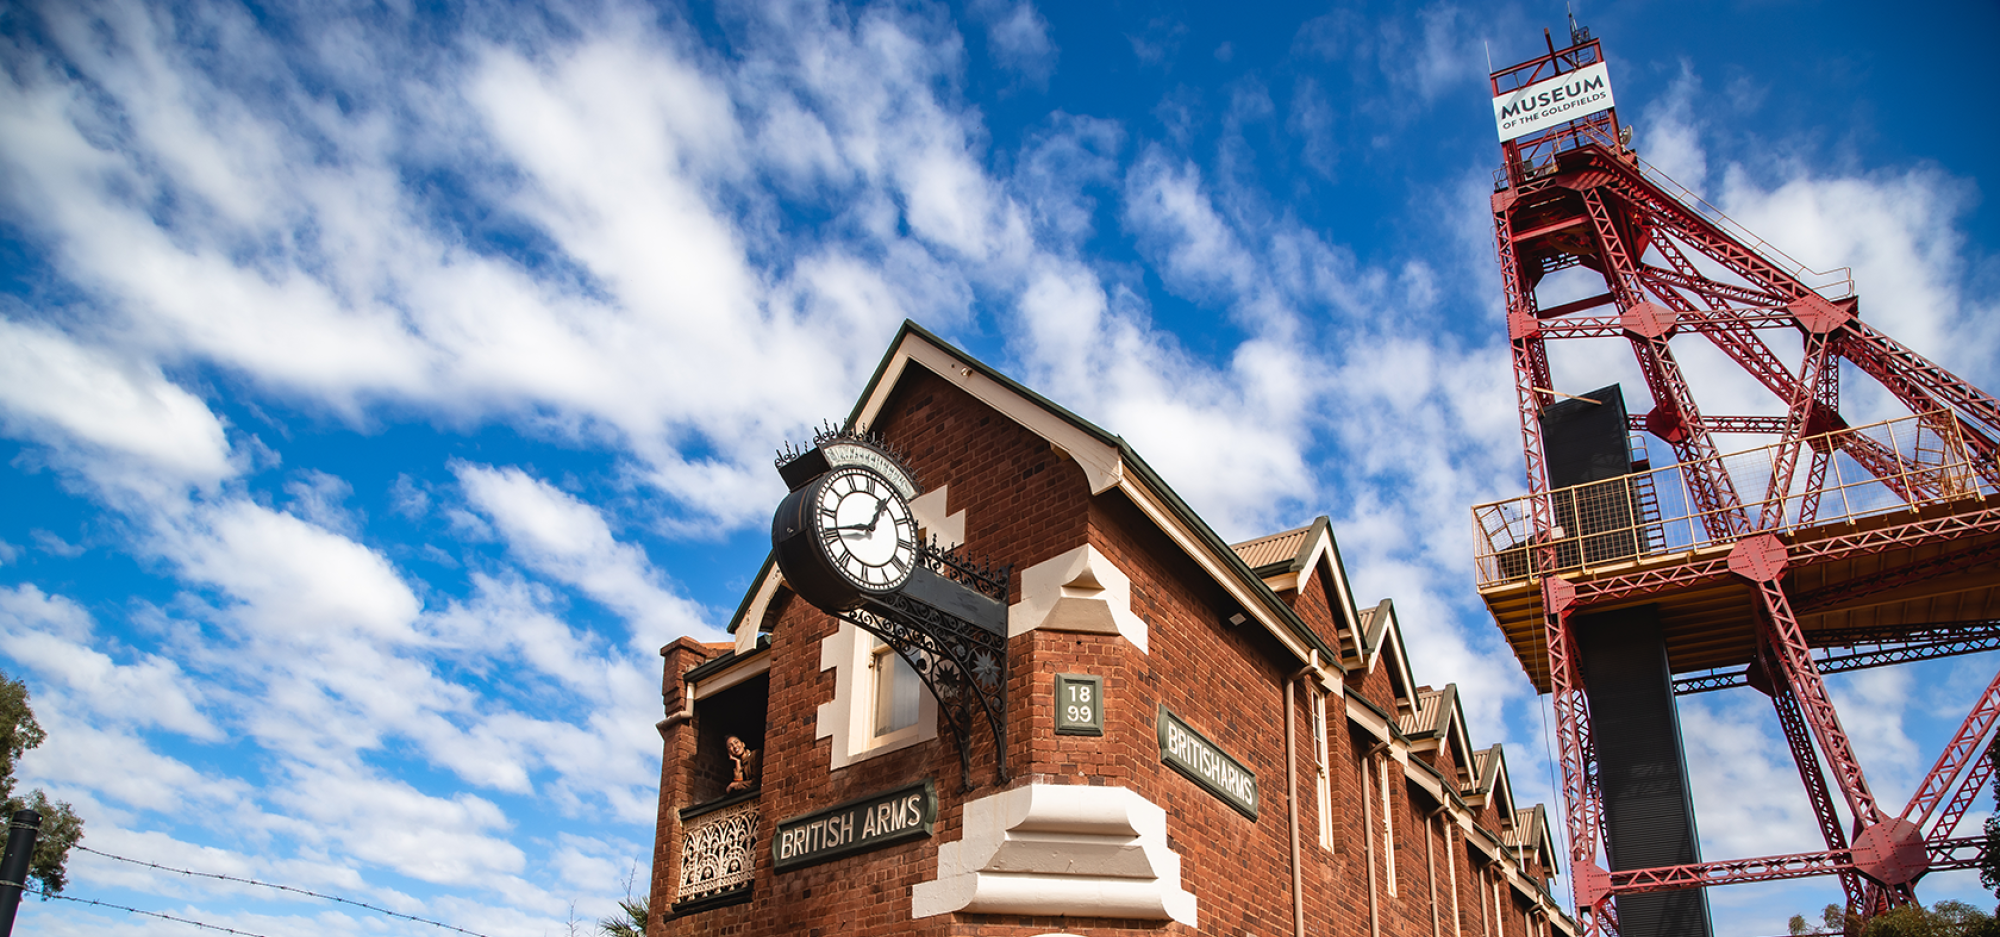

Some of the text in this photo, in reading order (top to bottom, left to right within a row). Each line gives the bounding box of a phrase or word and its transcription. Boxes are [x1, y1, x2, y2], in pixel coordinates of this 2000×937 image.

[1501, 74, 1604, 119] MUSEUM
[1502, 91, 1607, 130] OF THE GOLDFIELDS
[1068, 685, 1090, 702] 18
[1067, 705, 1092, 722] 99
[780, 793, 922, 860] BRITISH ARMS
